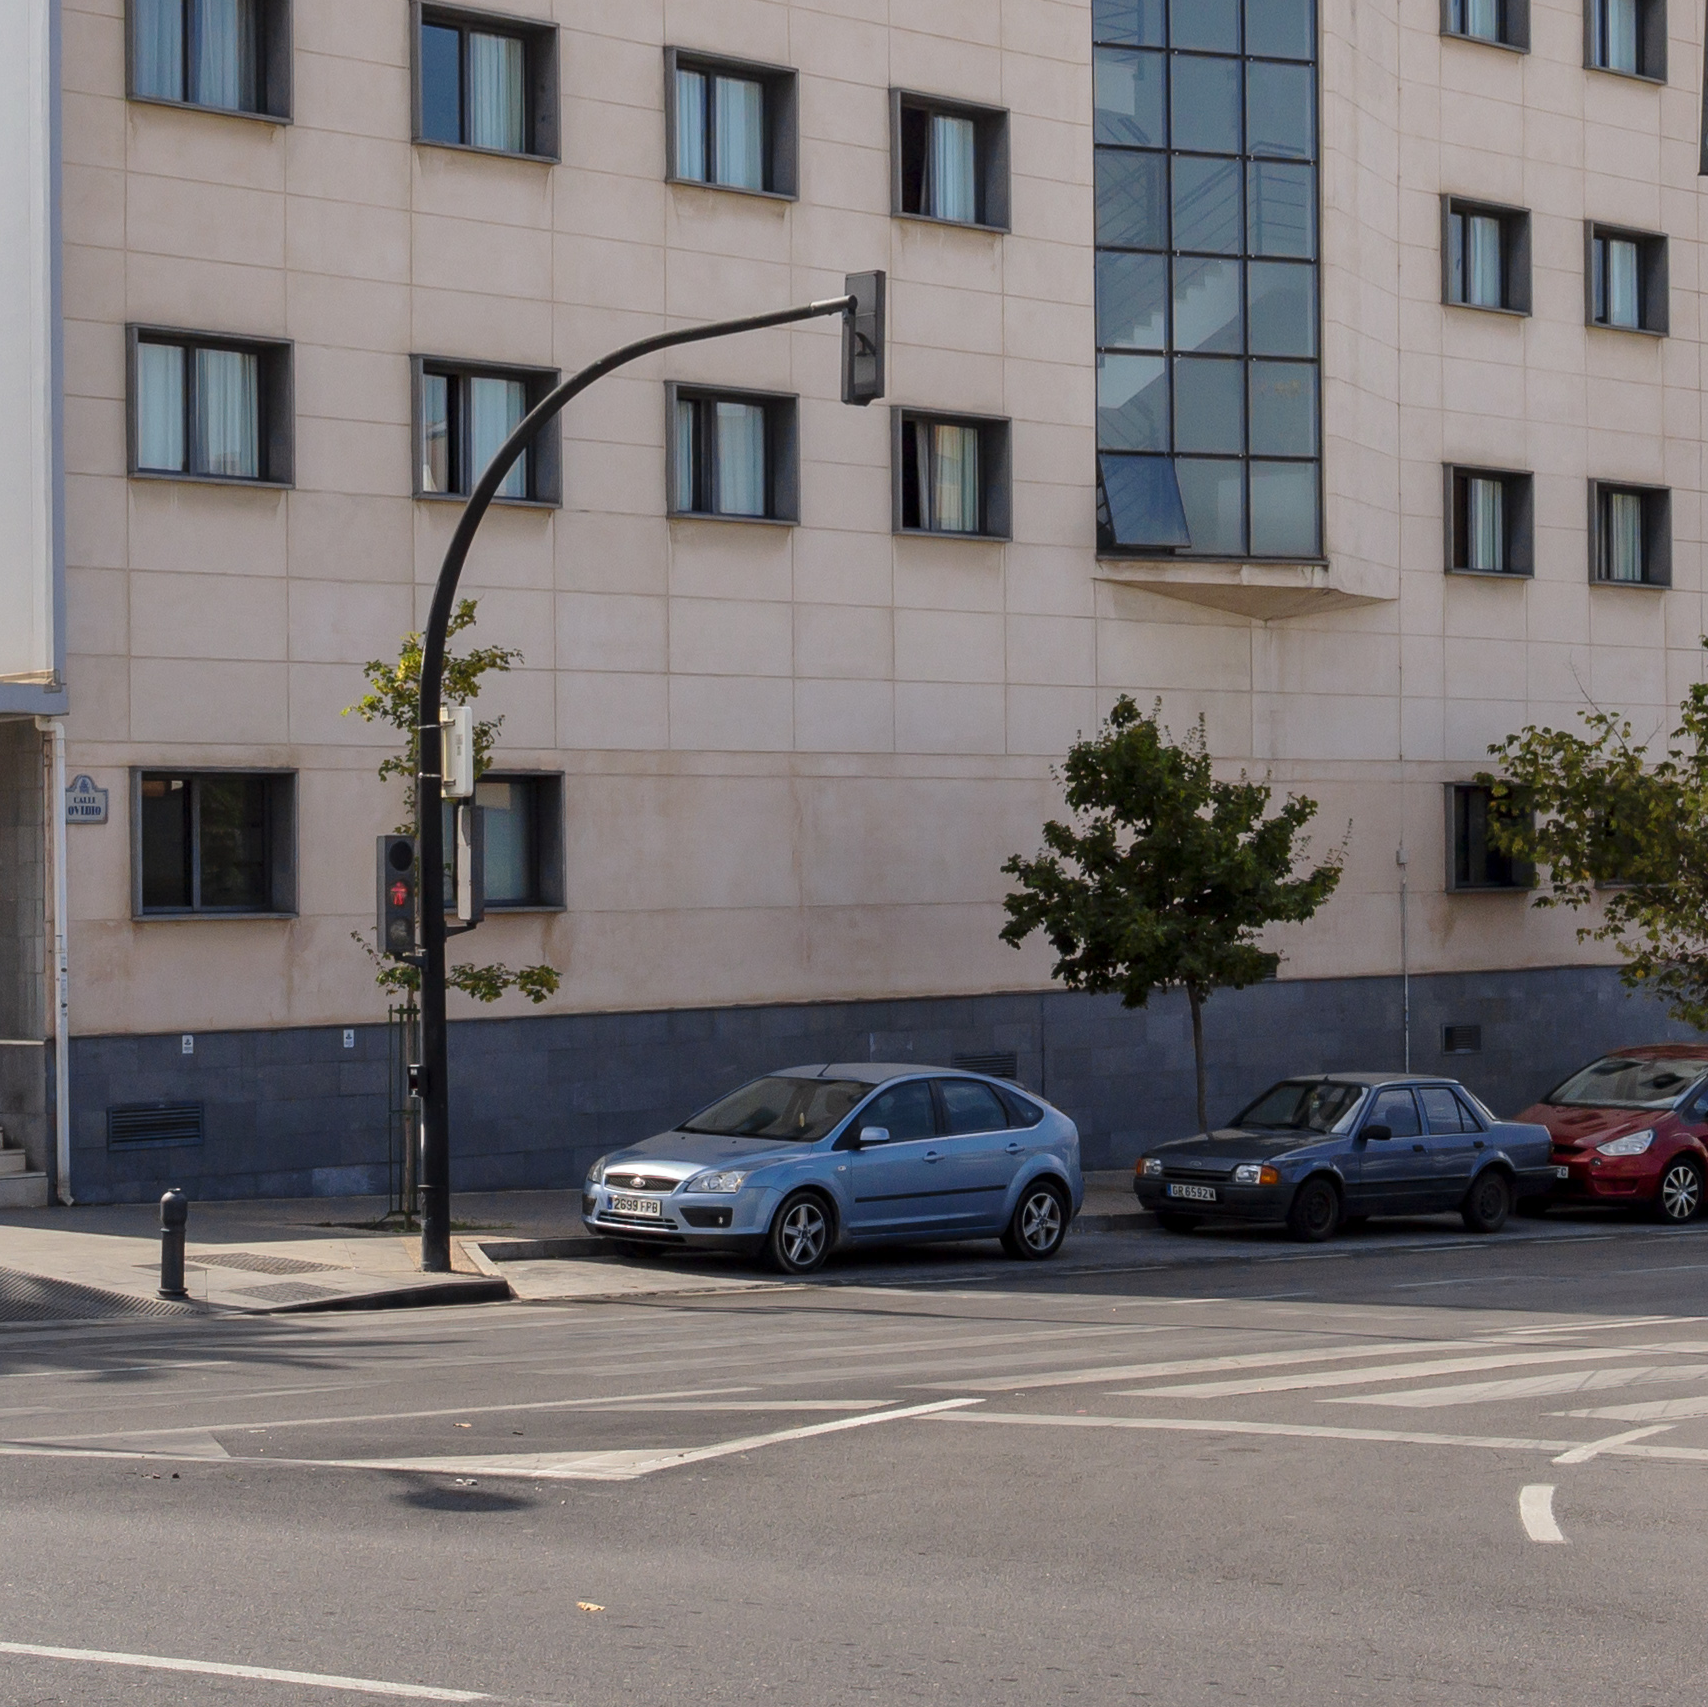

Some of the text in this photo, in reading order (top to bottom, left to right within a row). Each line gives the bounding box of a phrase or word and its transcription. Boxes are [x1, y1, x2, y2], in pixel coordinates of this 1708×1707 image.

[68, 806, 102, 816] OVIDIO
[614, 1198, 658, 1213] 2699 FPB
